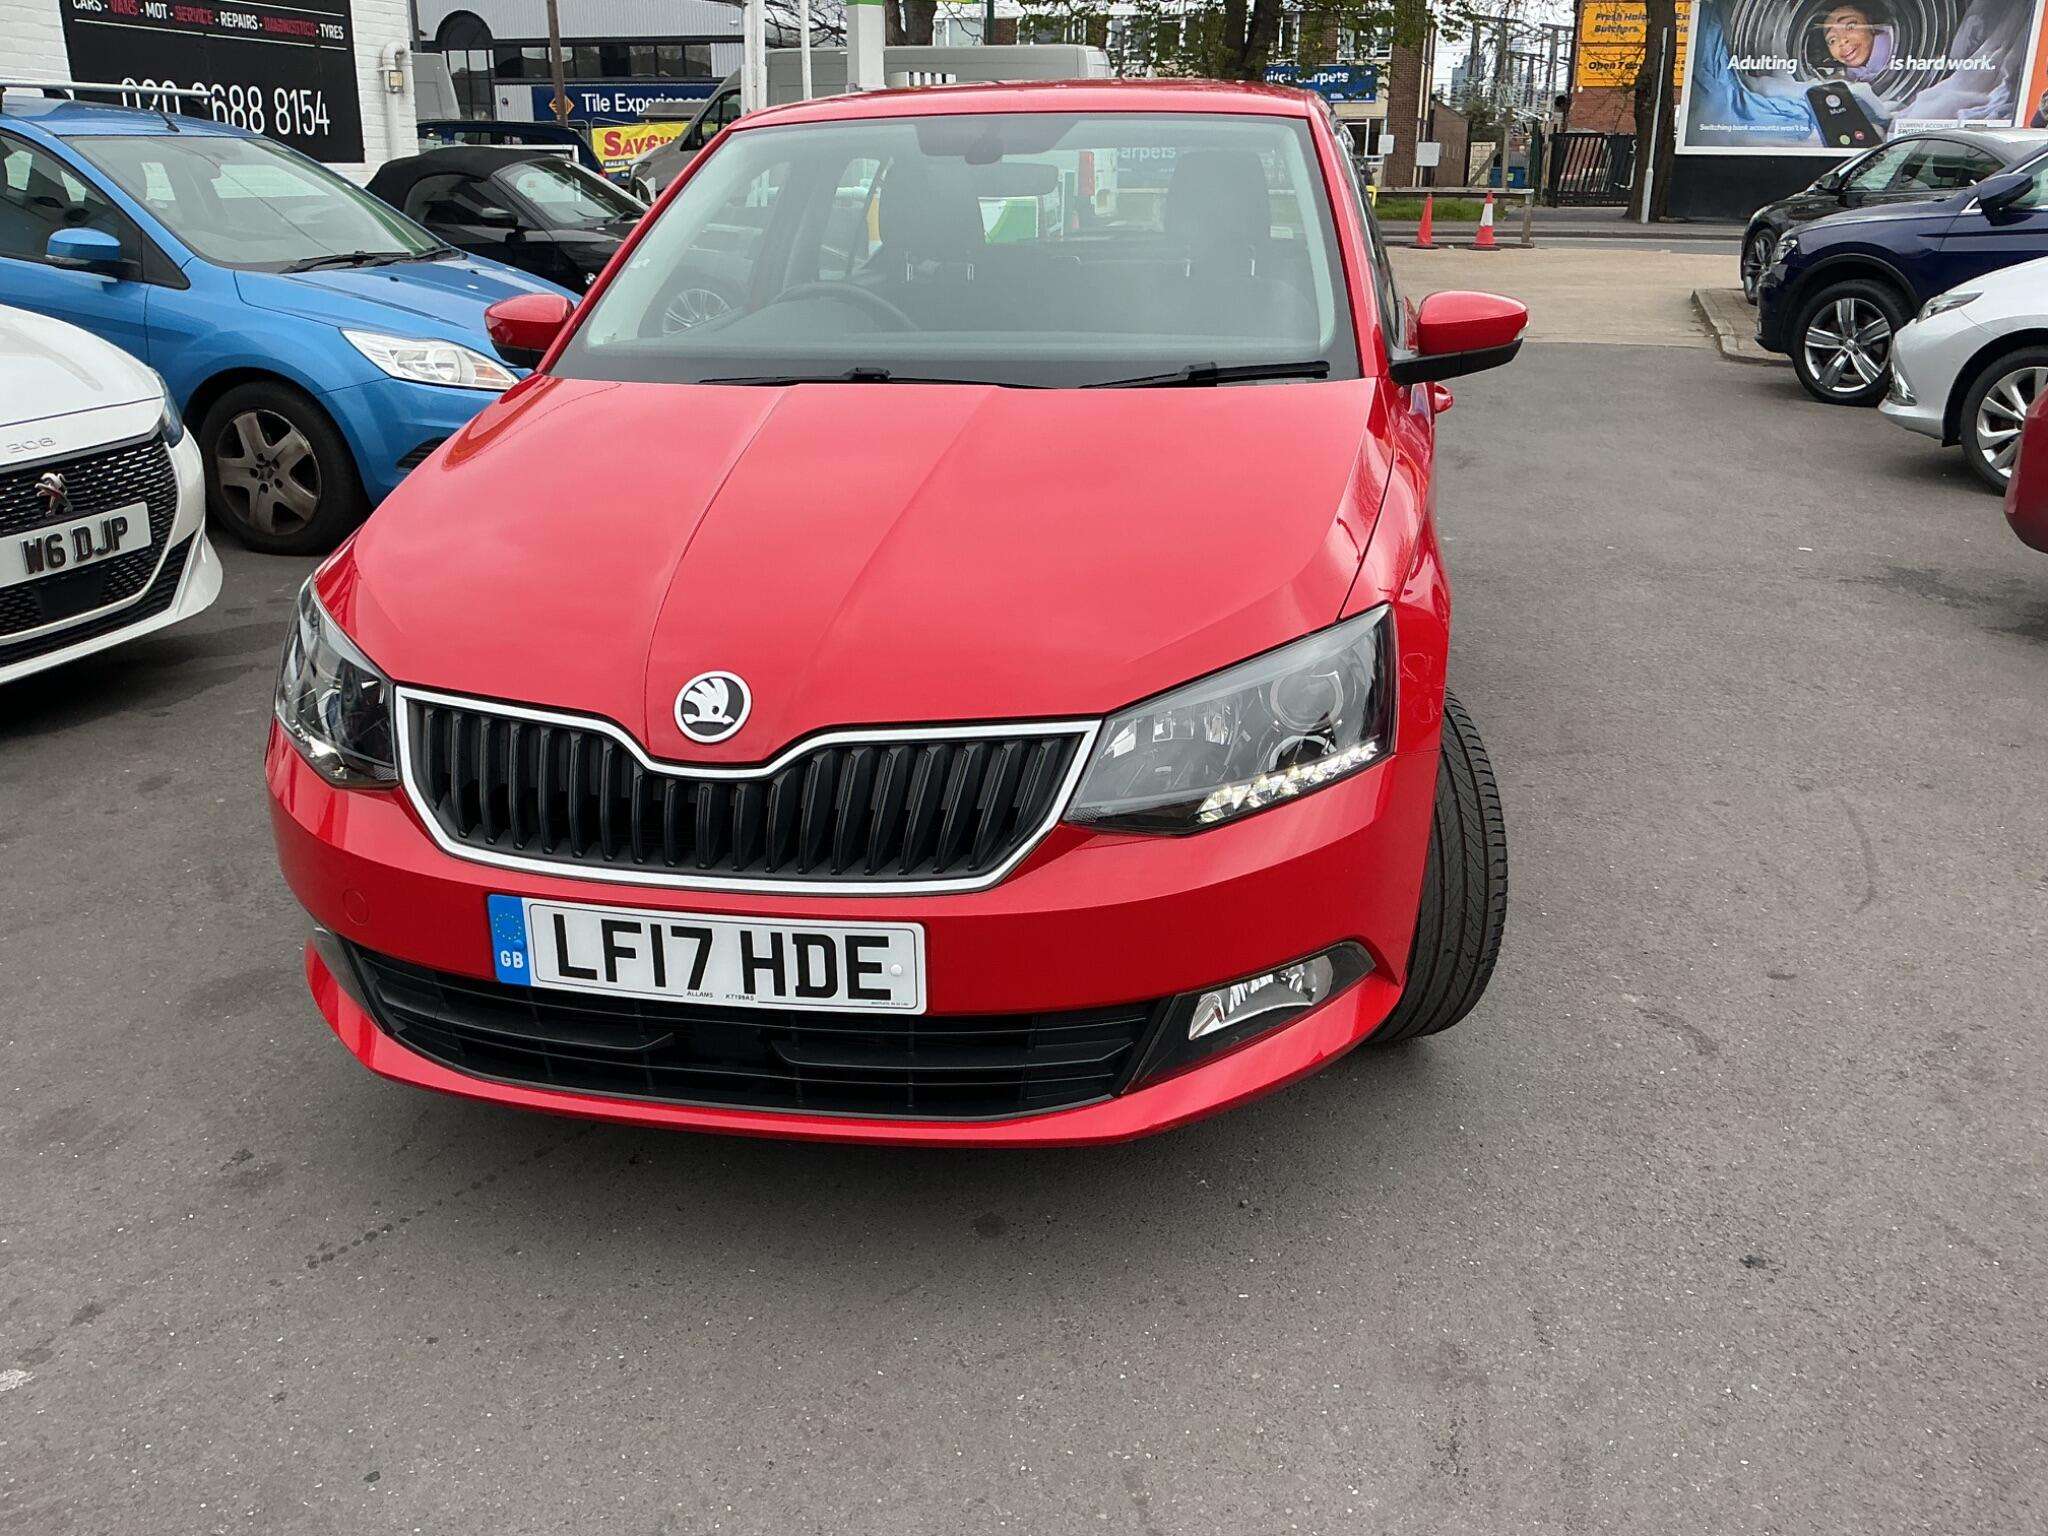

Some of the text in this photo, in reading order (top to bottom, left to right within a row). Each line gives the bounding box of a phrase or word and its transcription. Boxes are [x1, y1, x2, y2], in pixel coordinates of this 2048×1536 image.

[73, 0, 102, 12] CARS
[145, 2, 168, 19] MOT
[175, 6, 214, 24] SERVICE
[220, 12, 258, 30] REPAIRS
[320, 23, 344, 39] TYRES
[1625, 13, 1649, 21] Hala
[1588, 61, 1616, 71] Open
[1727, 55, 1798, 74] Adulting
[1889, 55, 1996, 70] is hard work.
[1296, 72, 1349, 85] rpets
[274, 87, 331, 136] 8154
[581, 93, 611, 113] Tile
[1699, 123, 1732, 132] Switching
[1117, 147, 1176, 161] arpets
[70, 516, 128, 563] DJP
[500, 950, 524, 969] GB
[552, 913, 892, 1001] LF17 HDE
[687, 990, 714, 999] ALLAMS
